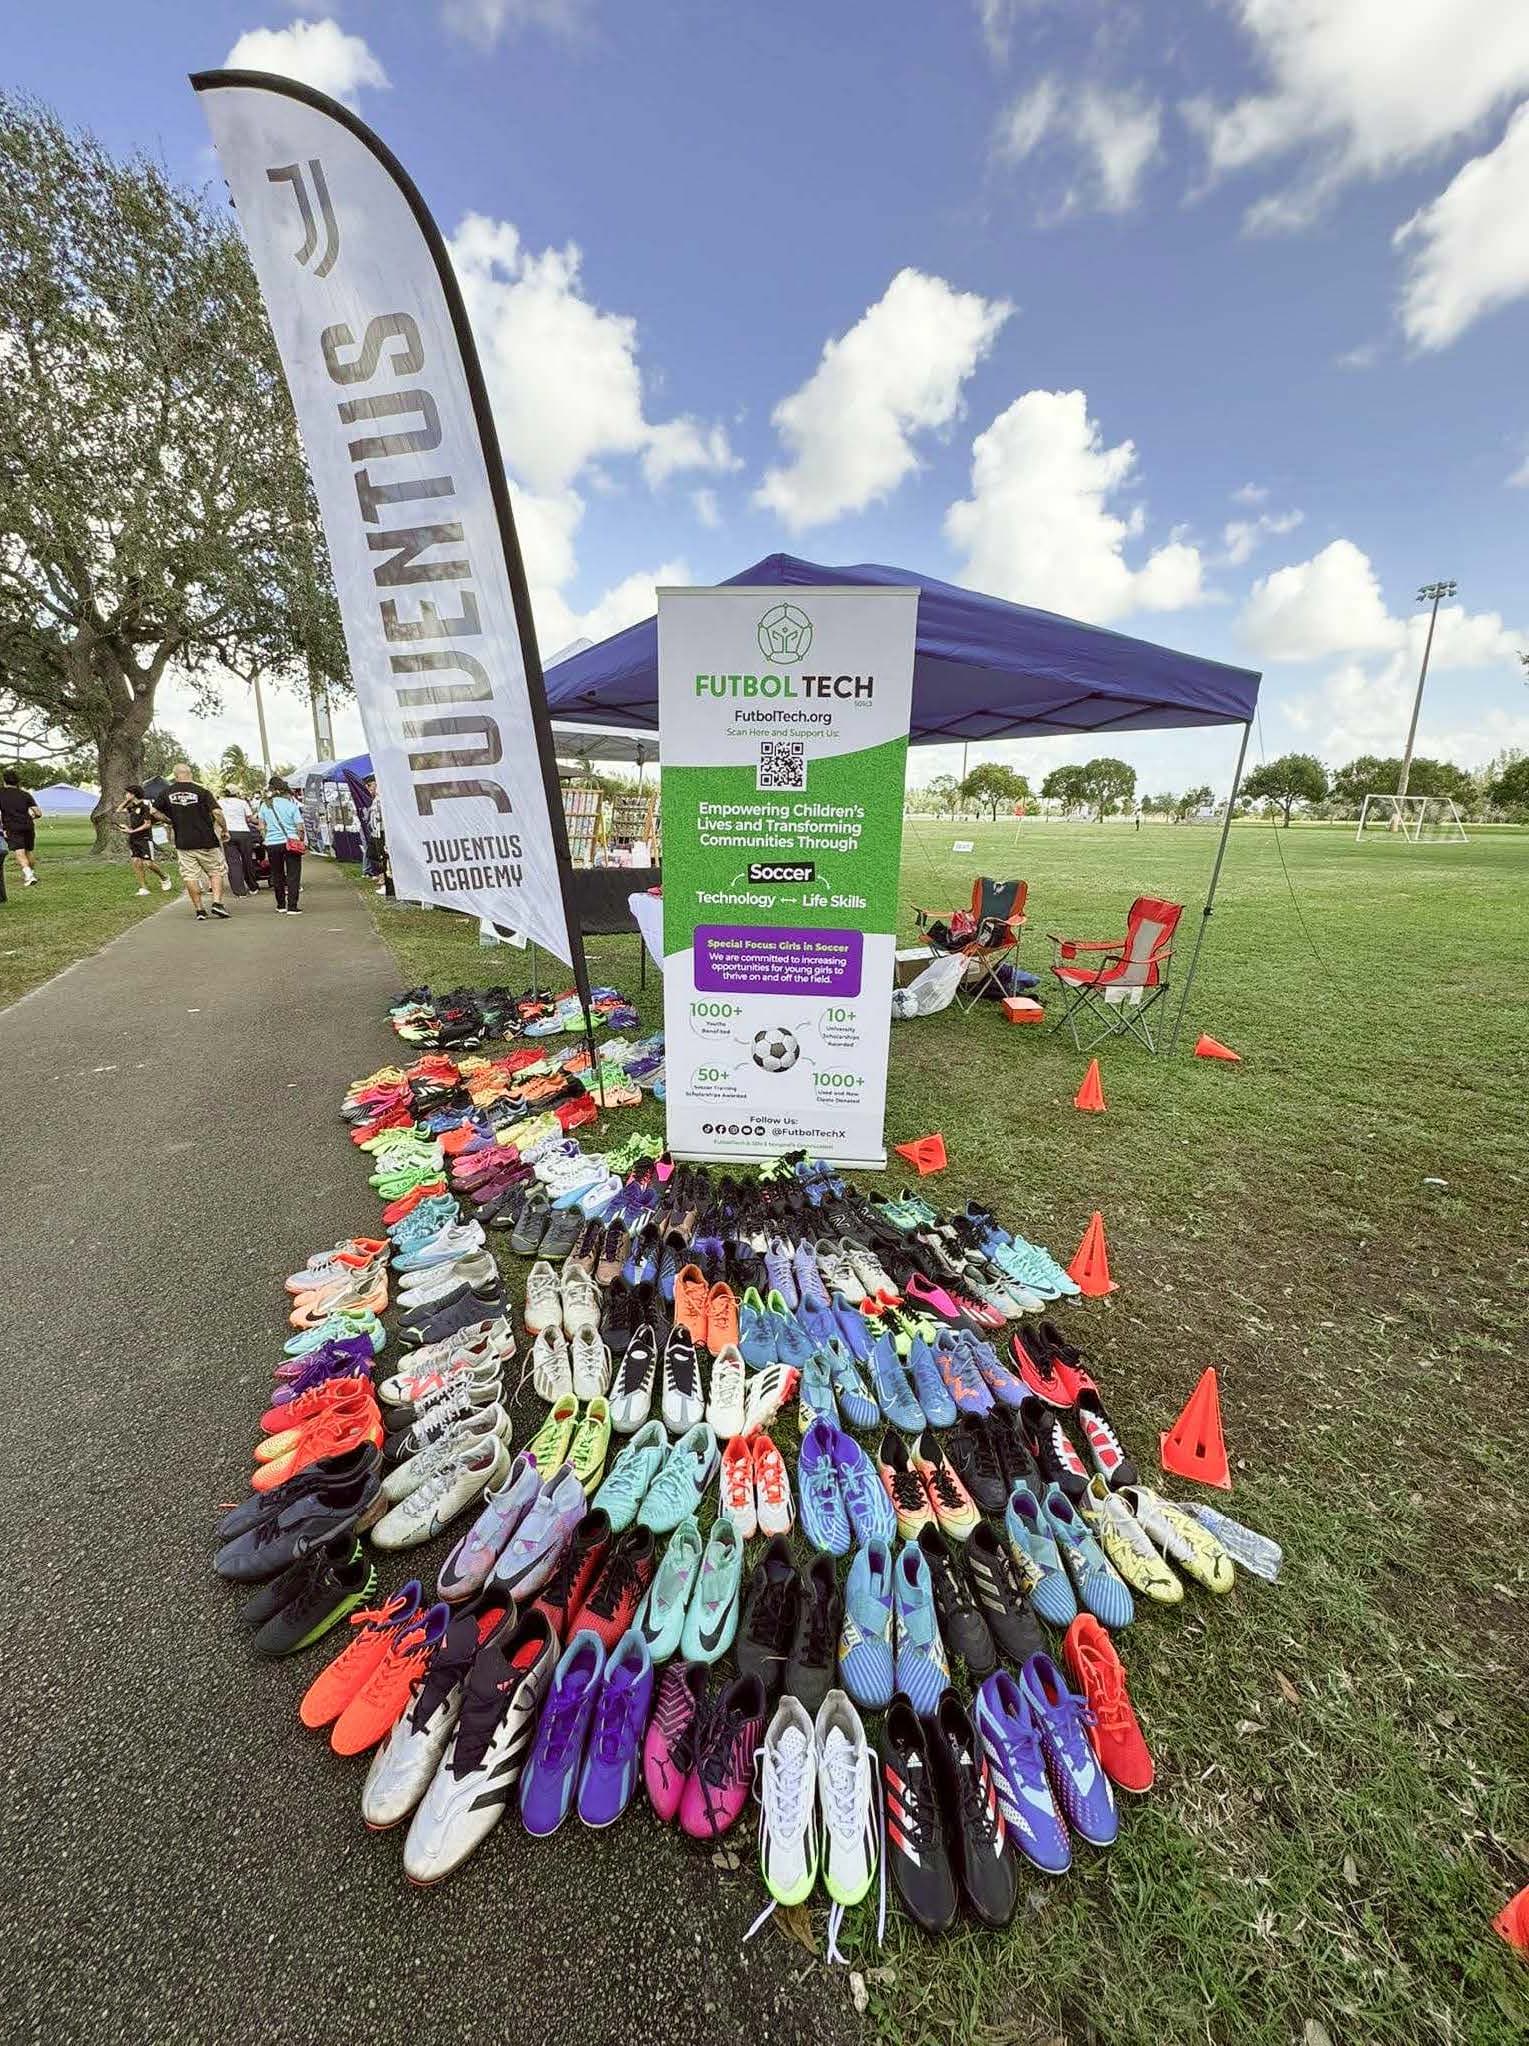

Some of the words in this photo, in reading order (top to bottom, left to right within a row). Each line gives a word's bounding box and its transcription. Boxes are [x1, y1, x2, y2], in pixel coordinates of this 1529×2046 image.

[321, 310, 513, 816] JUVENTUS
[695, 675, 798, 698] FUTBOL
[802, 675, 874, 699] TECH
[735, 710, 832, 726] FutbolTech.org
[726, 728, 748, 736] Scan
[749, 728, 770, 736] Here
[771, 728, 788, 737] and
[789, 729, 824, 738] Support
[699, 802, 790, 819] Empowering
[793, 803, 865, 818] Children's
[697, 817, 732, 831] Lives
[735, 819, 763, 832] and
[766, 819, 862, 837] Transforming
[422, 835, 523, 863] JUVENTUS
[700, 834, 794, 848] Communities
[797, 835, 858, 852] Through
[430, 864, 523, 892] ACADEMY
[750, 863, 813, 881] Soccer
[696, 891, 776, 908] Technology
[802, 894, 828, 907] Life
[830, 895, 867, 909] Skills
[707, 939, 743, 950] Special
[744, 940, 777, 950] Focus:
[779, 941, 801, 951] Girls
[803, 941, 813, 951] in
[815, 942, 849, 952] Soccer
[709, 952, 724, 960] We
[740, 953, 789, 963] committed
[790, 956, 801, 964] to
[801, 955, 847, 967] increasing
[711, 962, 770, 972] opportunities
[771, 963, 783, 972] for
[784, 966, 812, 975] young
[814, 966, 833, 976] girls
[834, 967, 844, 975] to
[723, 972, 748, 980] thrive
[762, 973, 779, 982] and
[780, 974, 793, 982] off
[794, 974, 809, 983] the
[810, 975, 833, 984] field.
[690, 1003, 743, 1018] 1000+
[827, 1008, 857, 1023] 10+
[698, 1068, 729, 1082] 50+
[812, 1073, 865, 1088] 1000+
[750, 1115, 781, 1124] Follow
[783, 1117, 799, 1125] Us:
[771, 1127, 846, 1138] @FutbolTechX
